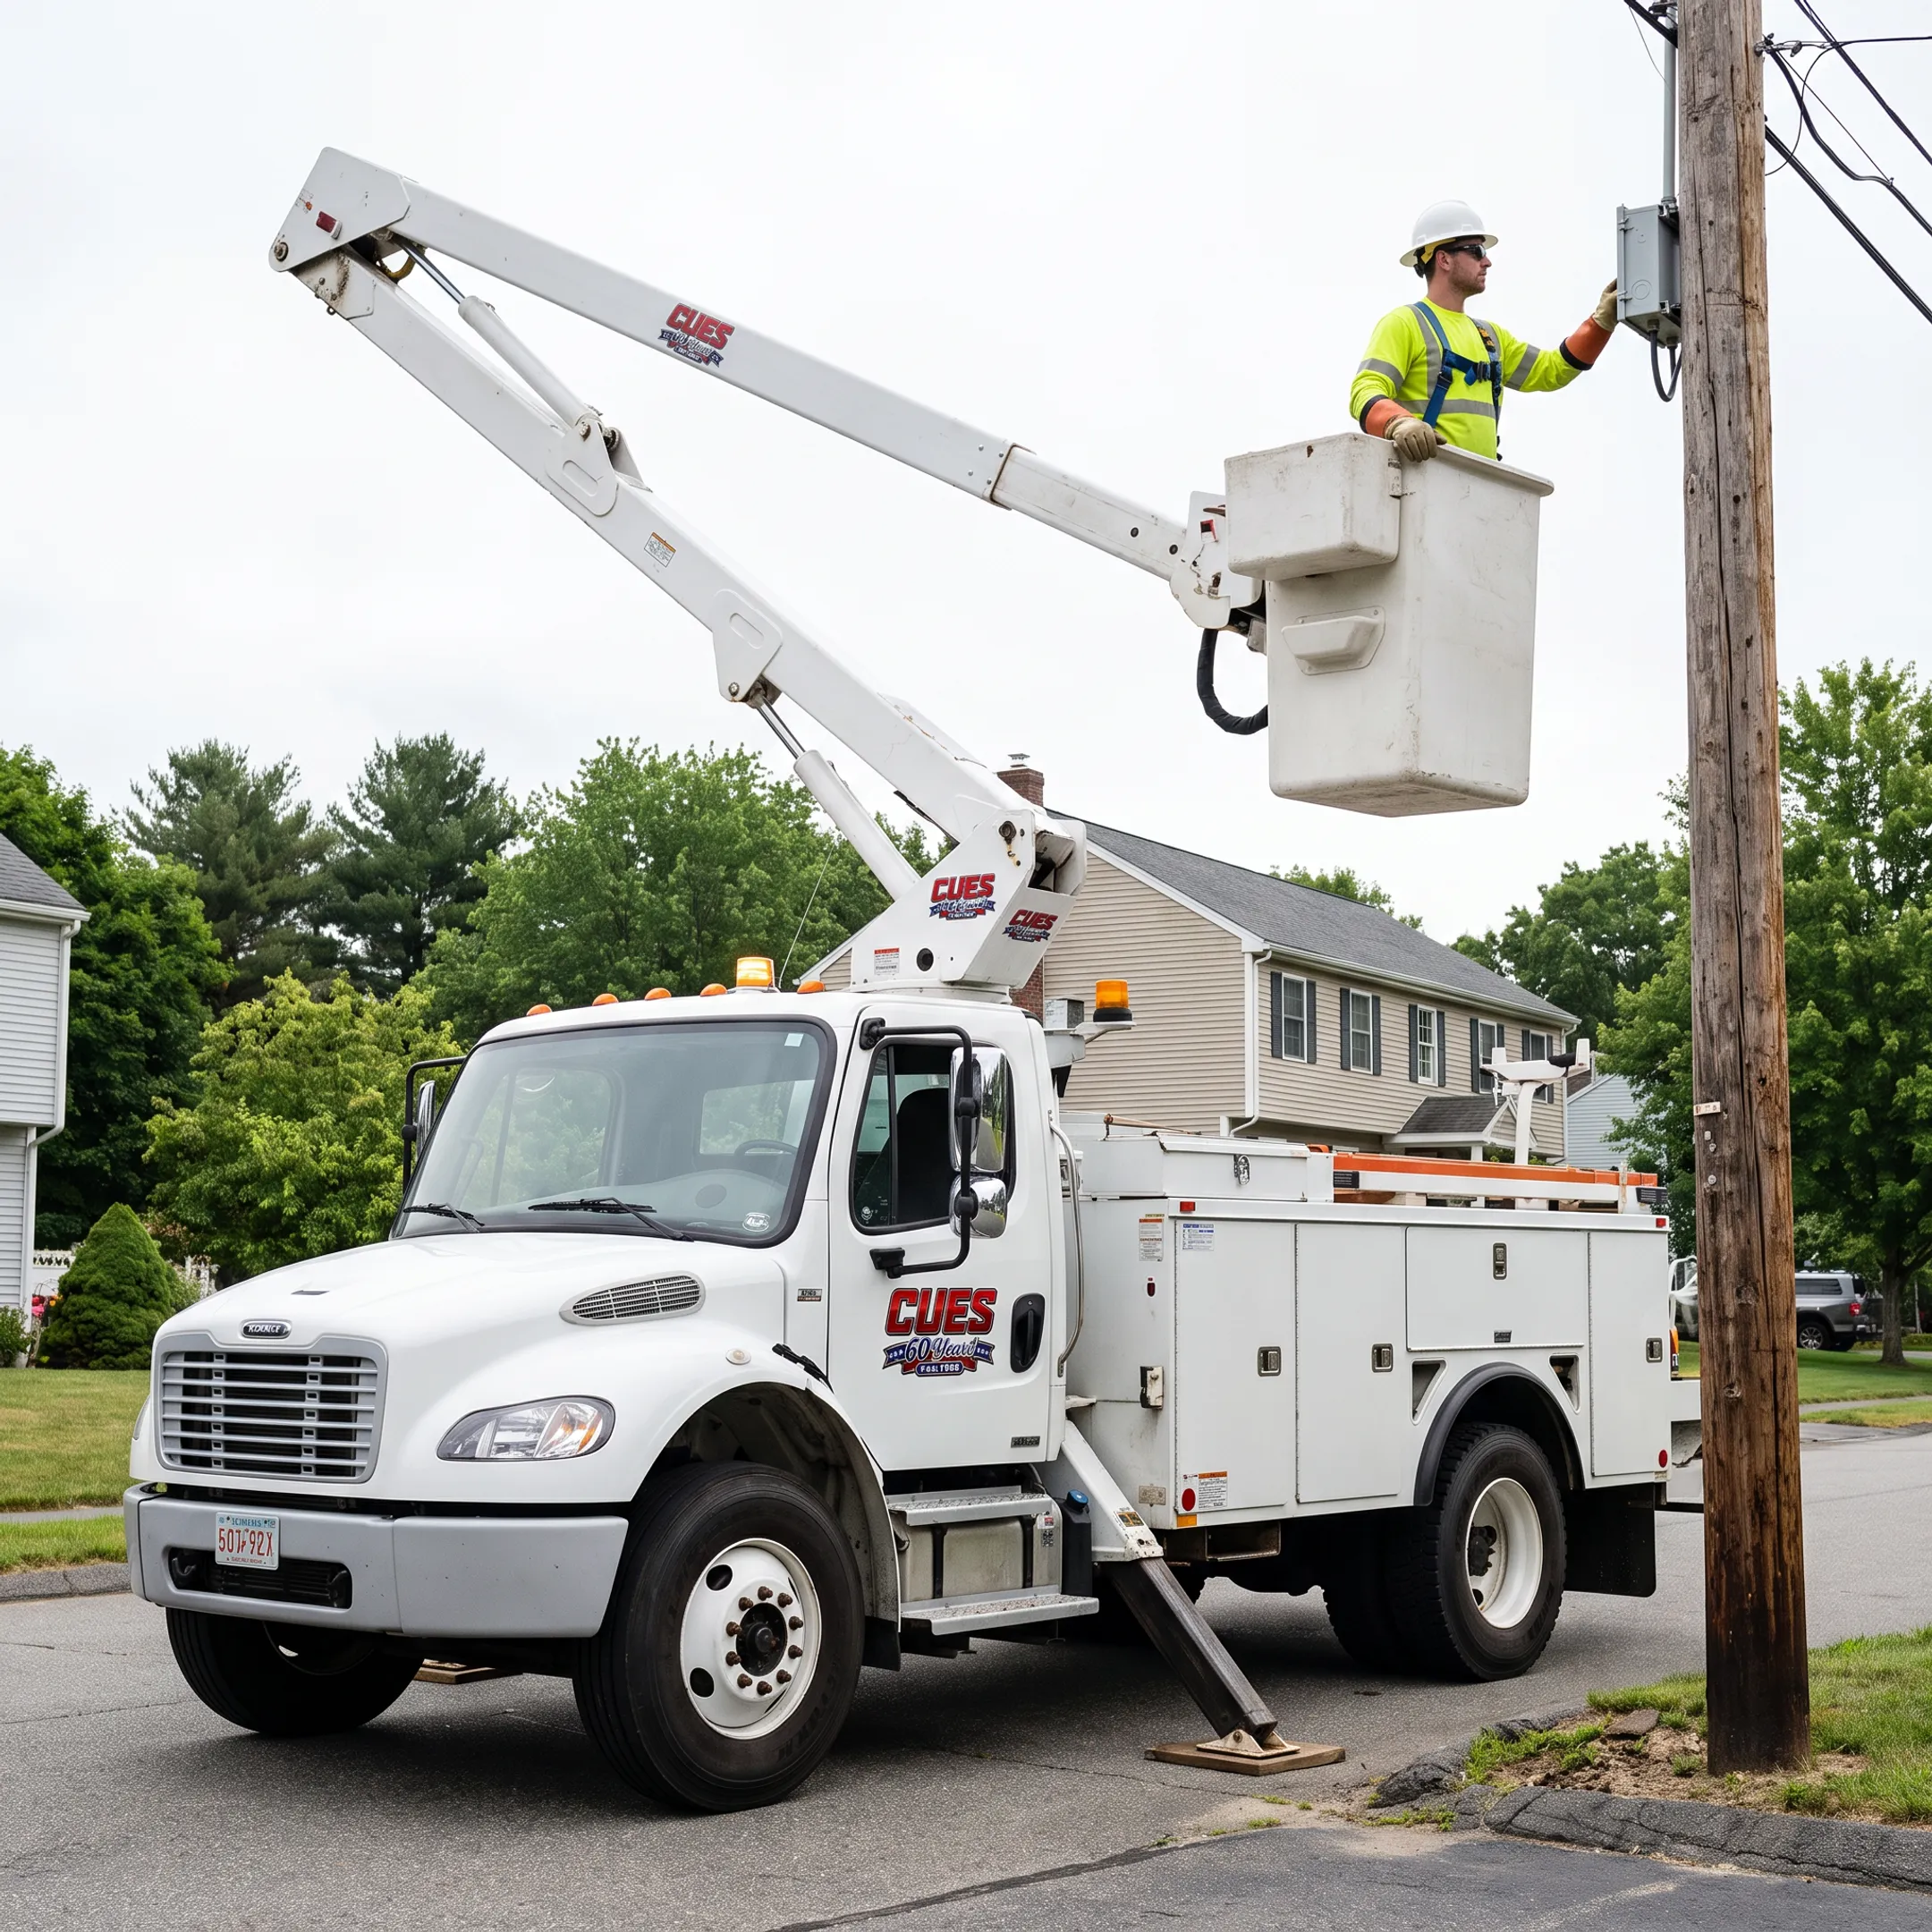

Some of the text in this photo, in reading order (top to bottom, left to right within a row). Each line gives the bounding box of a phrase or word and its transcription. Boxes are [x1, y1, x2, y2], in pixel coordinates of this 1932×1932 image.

[666, 303, 734, 350] CUES
[931, 873, 996, 902] CUES
[1009, 910, 1058, 930] CUES
[885, 1288, 997, 1335] CUES
[905, 1337, 930, 1362] 60
